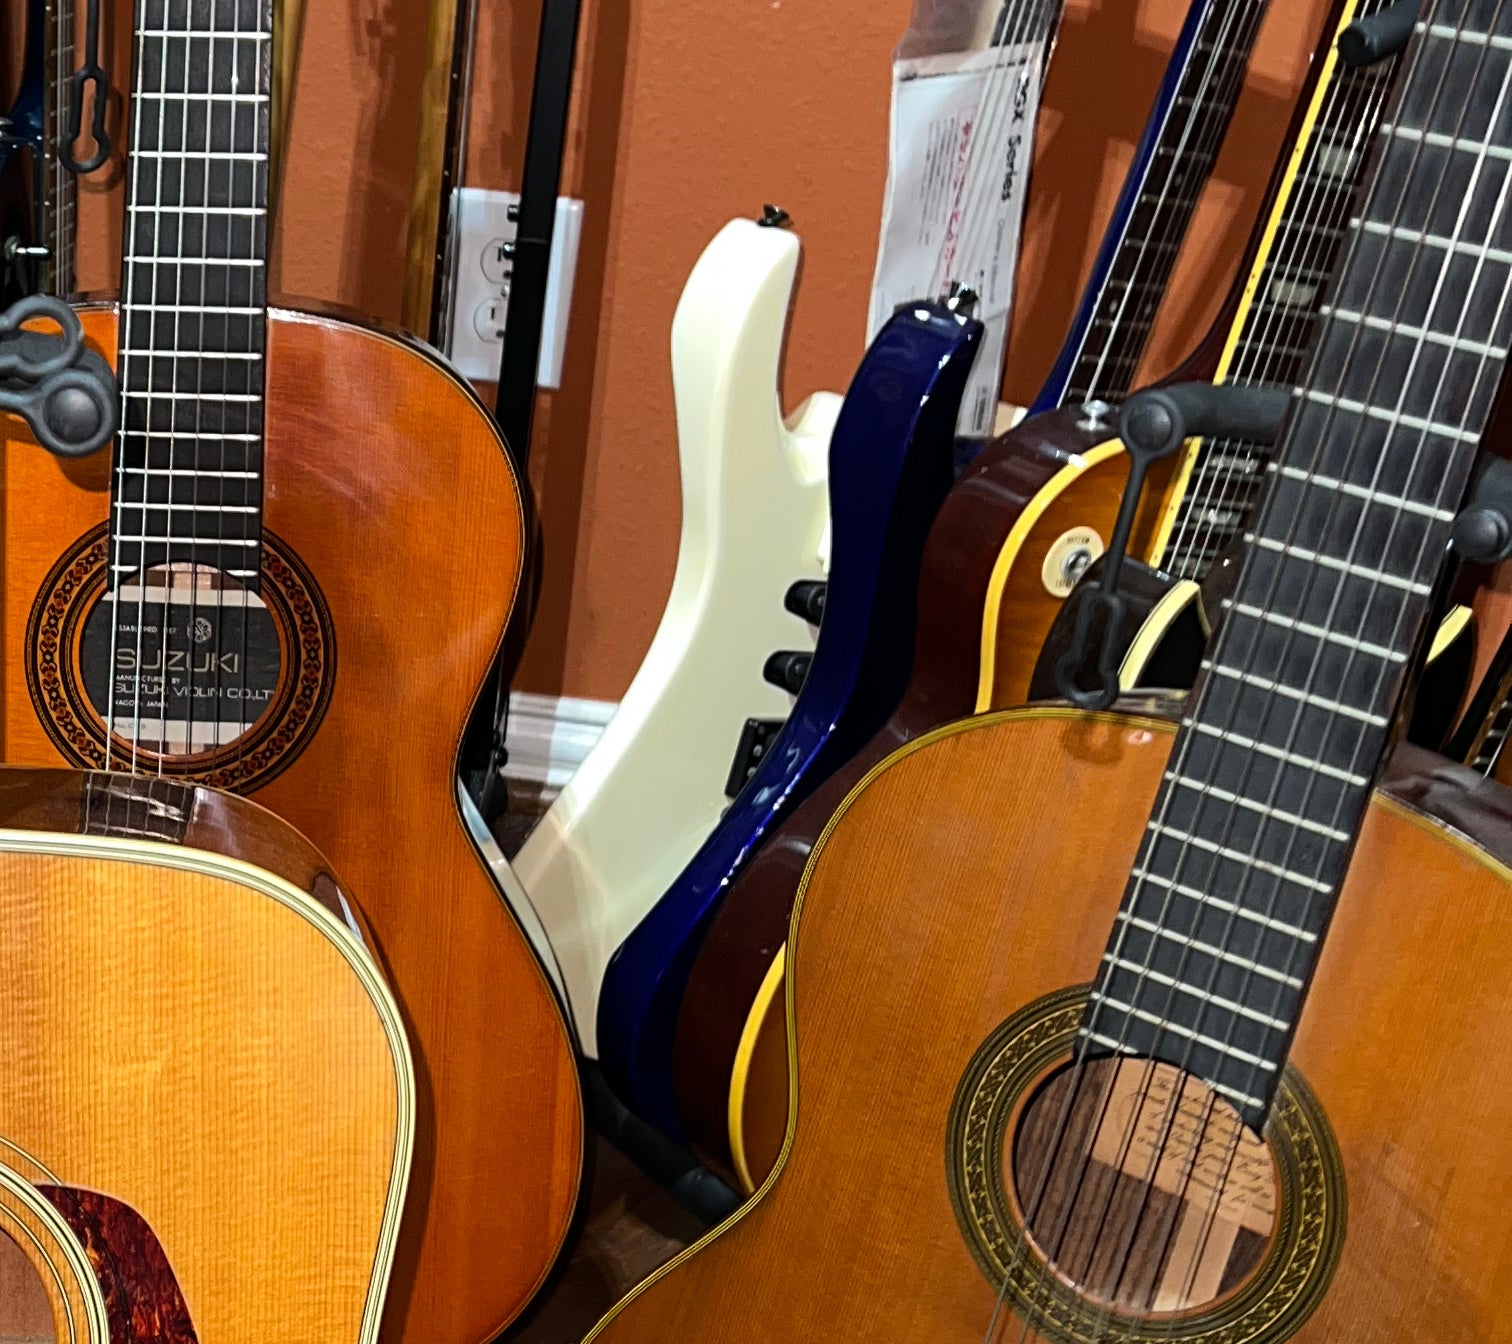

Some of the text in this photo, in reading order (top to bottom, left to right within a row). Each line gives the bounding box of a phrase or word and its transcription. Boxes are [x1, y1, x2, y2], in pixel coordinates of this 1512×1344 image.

[1001, 133, 1022, 202] Series
[116, 647, 239, 674] SUZUKI
[173, 686, 223, 698] VIOLIN
